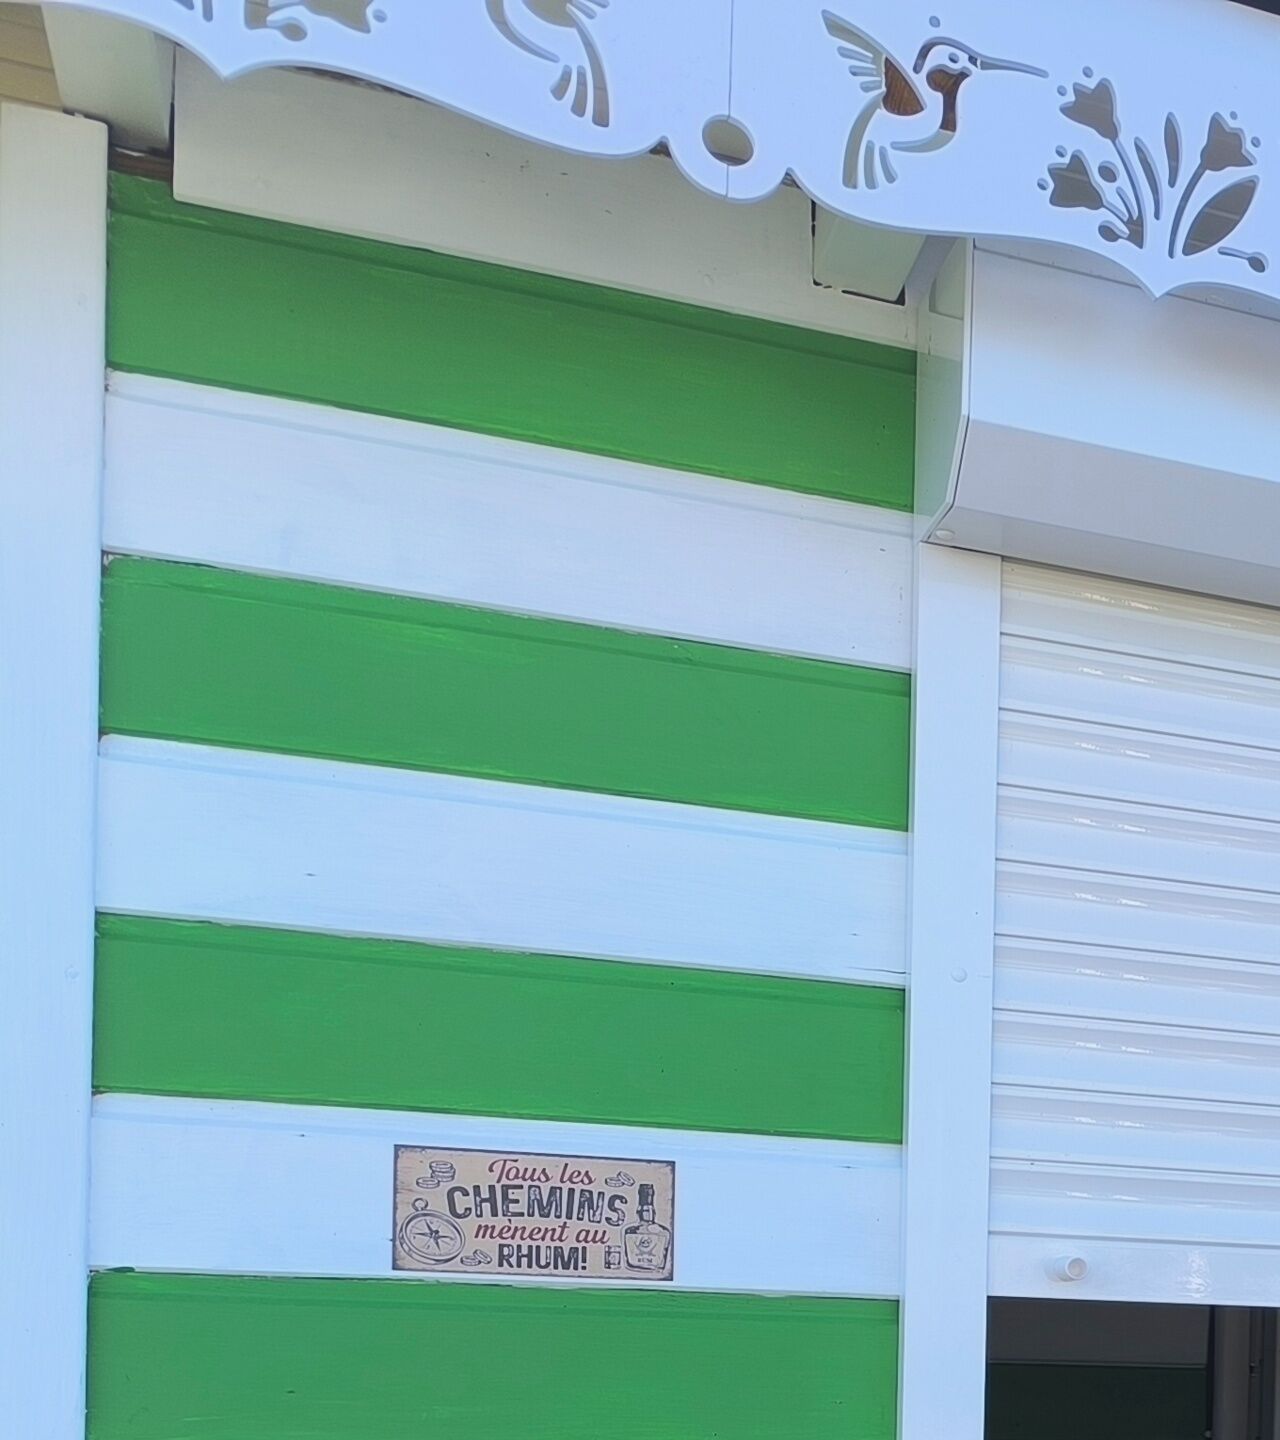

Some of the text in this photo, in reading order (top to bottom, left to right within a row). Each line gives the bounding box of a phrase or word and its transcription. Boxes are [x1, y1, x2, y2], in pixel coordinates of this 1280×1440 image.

[488, 1158, 596, 1186] Tous les
[446, 1183, 629, 1227] CHEMINS
[474, 1218, 610, 1245] mènent au
[497, 1243, 588, 1271] RHUM!
